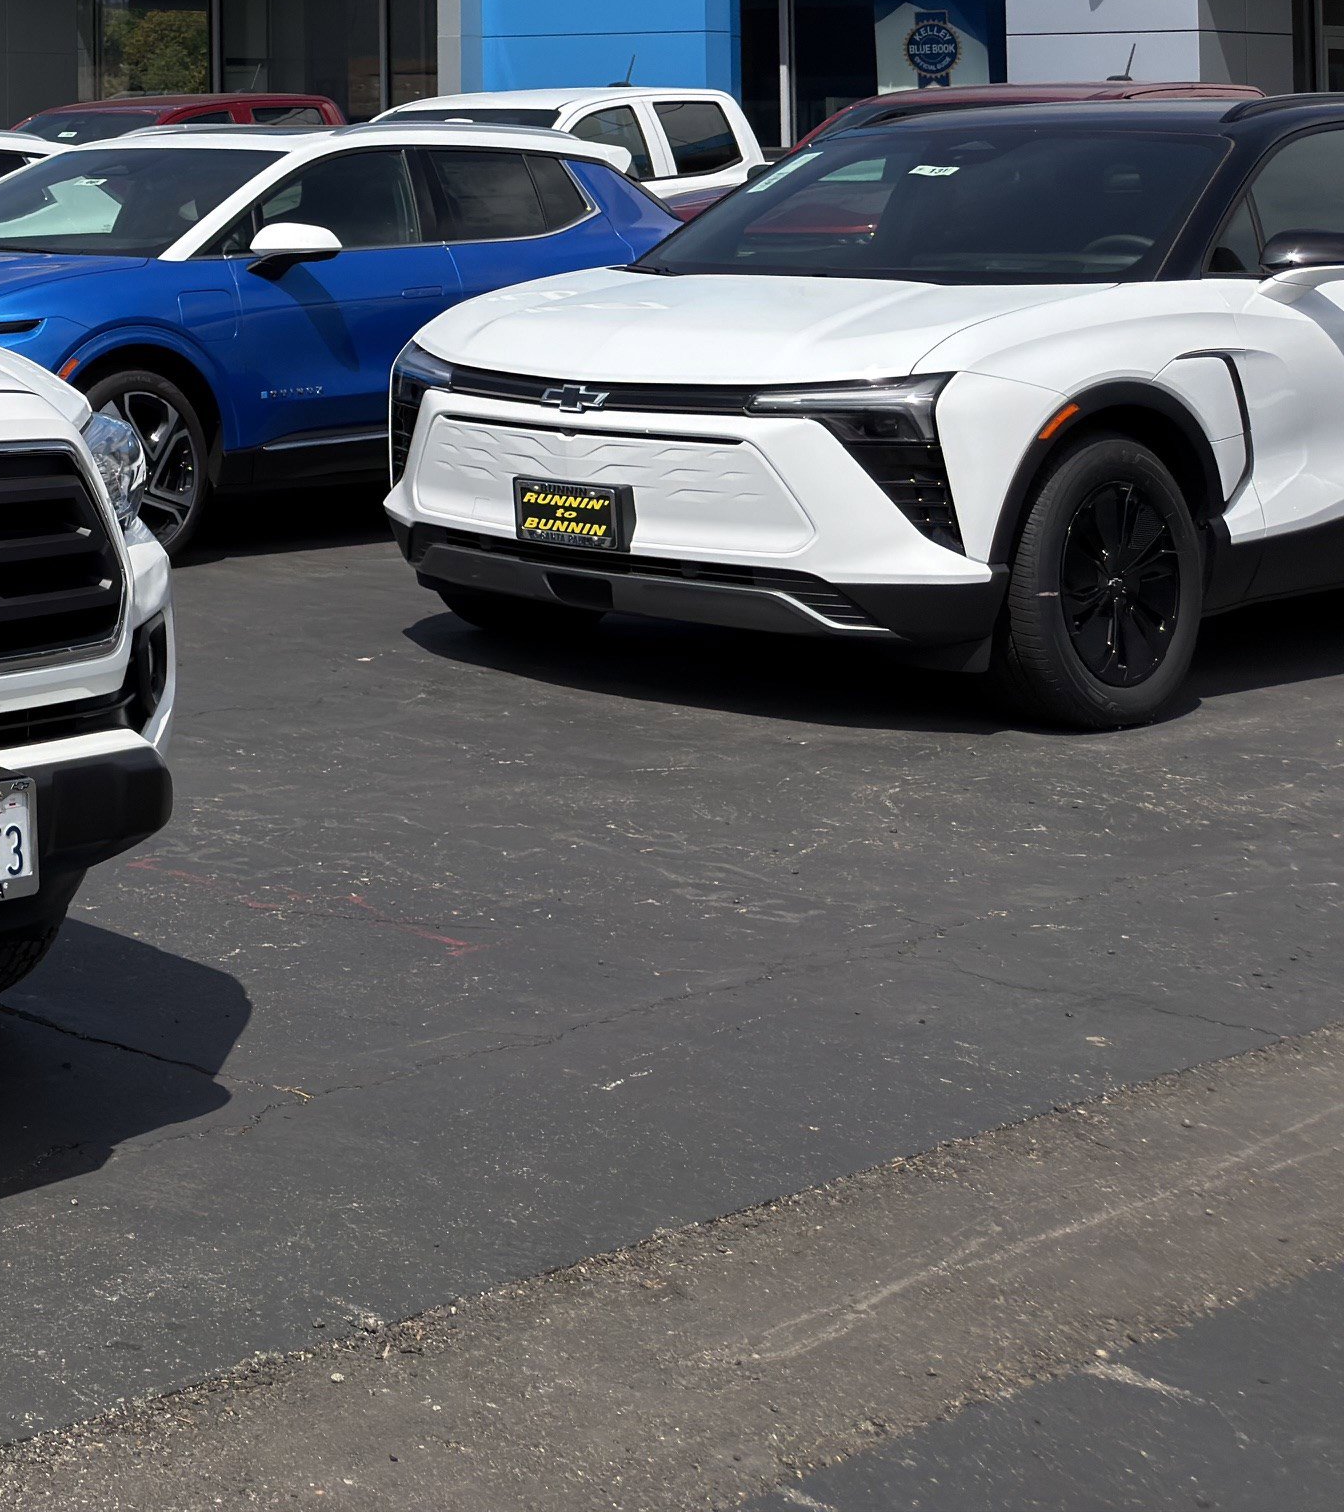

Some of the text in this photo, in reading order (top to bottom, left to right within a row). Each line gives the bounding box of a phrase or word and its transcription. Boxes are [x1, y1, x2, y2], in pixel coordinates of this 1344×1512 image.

[914, 26, 952, 41] KELLEY
[909, 43, 955, 54] BLUE BOOK
[522, 492, 610, 510] RUNNIN'
[555, 508, 578, 519] to
[524, 516, 607, 536] BUNNIN
